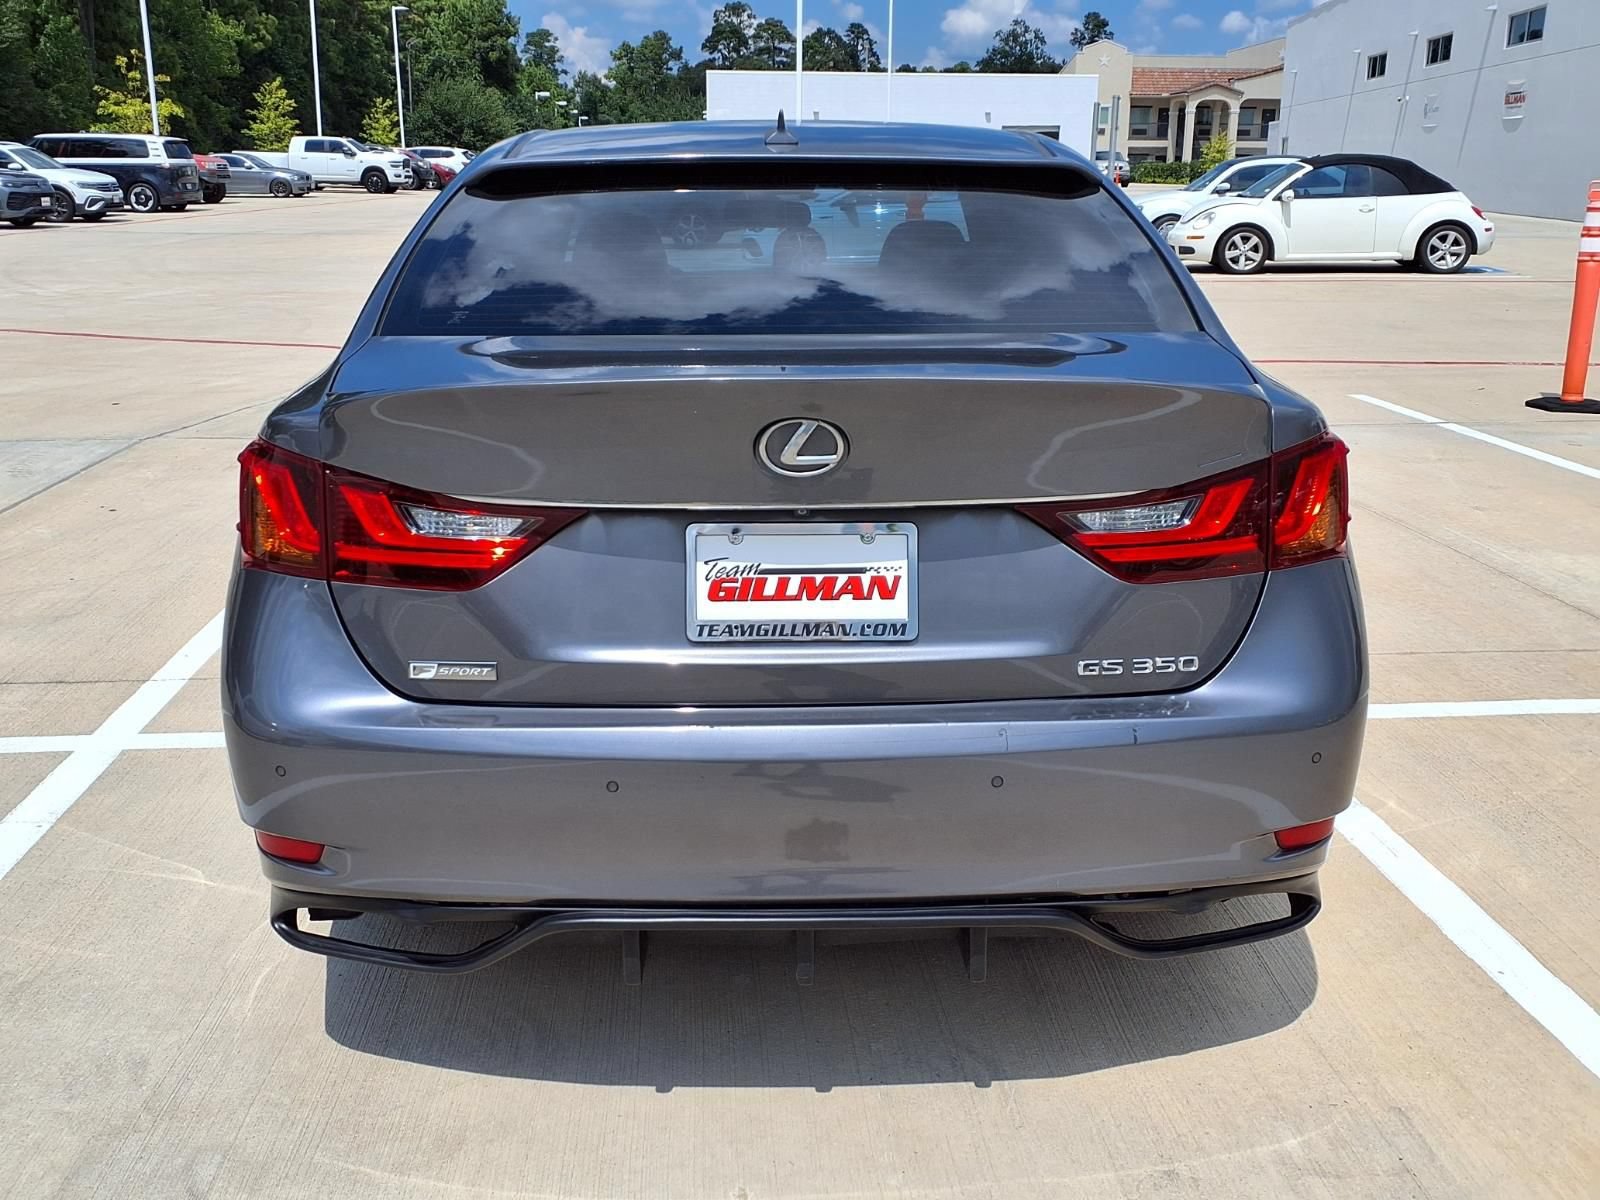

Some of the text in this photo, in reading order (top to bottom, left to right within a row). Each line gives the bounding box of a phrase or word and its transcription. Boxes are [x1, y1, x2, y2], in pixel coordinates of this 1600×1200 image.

[704, 557, 761, 582] Team
[707, 576, 902, 602] GILLMAN
[696, 623, 907, 637] TEAMGILLMAN.COM
[438, 667, 492, 676] SPORT
[1077, 656, 1199, 676] GS 350
